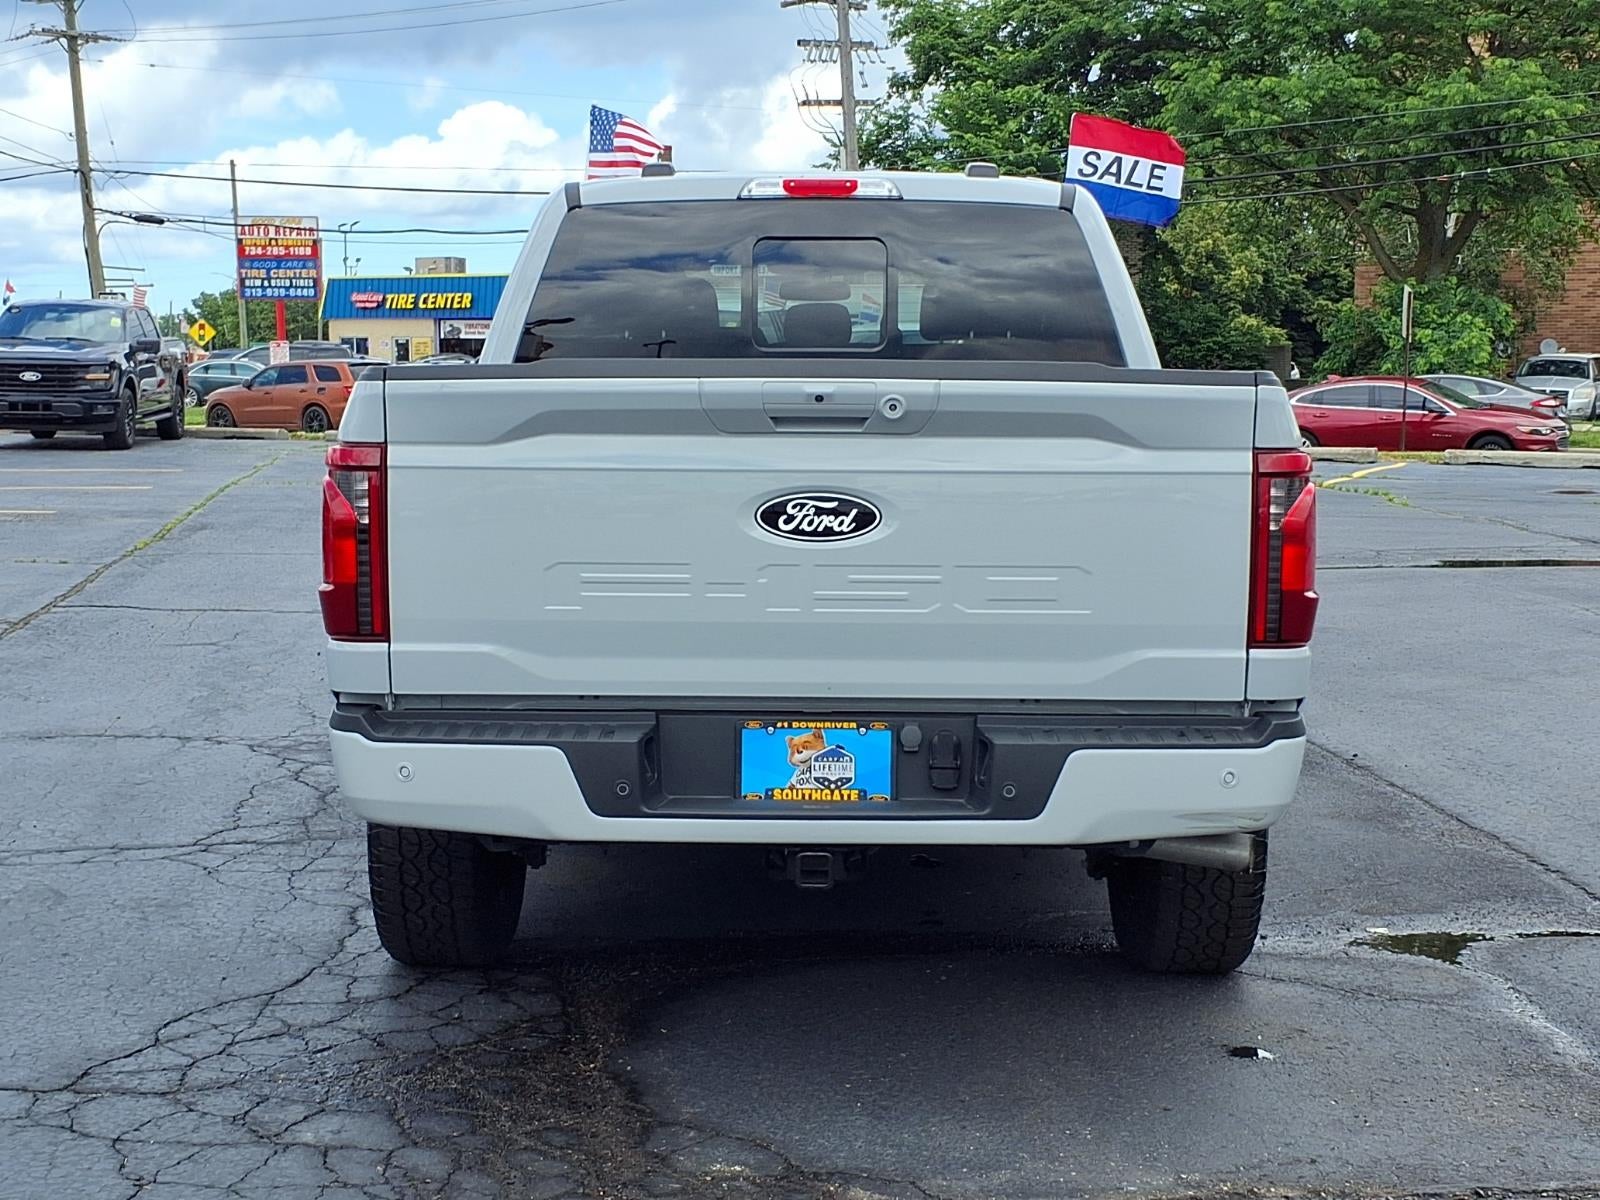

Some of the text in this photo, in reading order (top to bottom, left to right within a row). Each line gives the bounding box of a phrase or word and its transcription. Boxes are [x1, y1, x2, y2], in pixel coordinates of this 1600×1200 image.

[1077, 150, 1168, 193] SALE
[240, 225, 315, 237] AUTO REPAIR
[240, 269, 317, 278] TIRE CENTER
[245, 279, 314, 287] NEW & USED TIRES
[385, 292, 473, 309] TIRE CENTER
[777, 499, 858, 533] Ford
[776, 721, 789, 729] #1
[792, 721, 857, 729] DOWNRIVER
[813, 763, 854, 772] LIFETIME
[773, 789, 859, 801] SOUTHGATE
